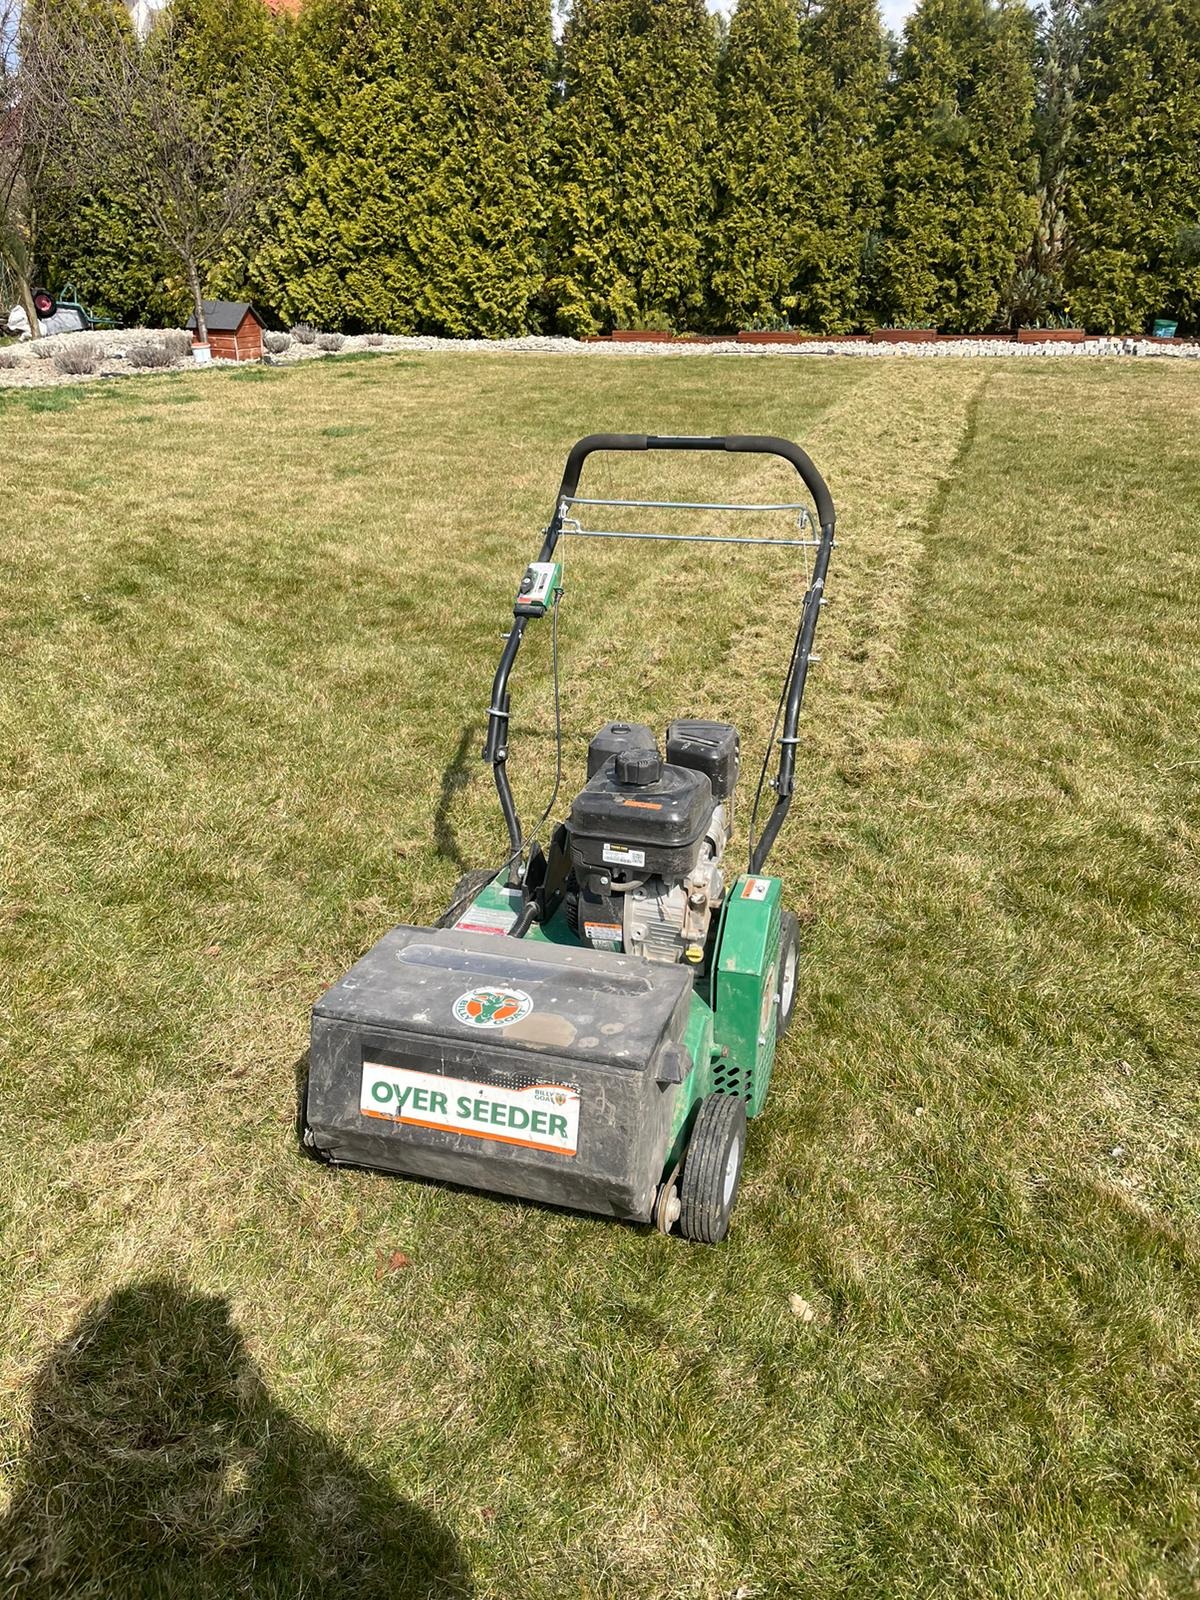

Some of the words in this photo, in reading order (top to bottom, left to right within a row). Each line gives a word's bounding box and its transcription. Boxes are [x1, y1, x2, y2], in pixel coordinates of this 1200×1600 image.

[458, 1000, 470, 1020] BILLY
[493, 1008, 525, 1025] GOAT
[534, 1089, 554, 1097] BILLY
[371, 1081, 448, 1115] OVER
[456, 1096, 569, 1139] SEEDER
